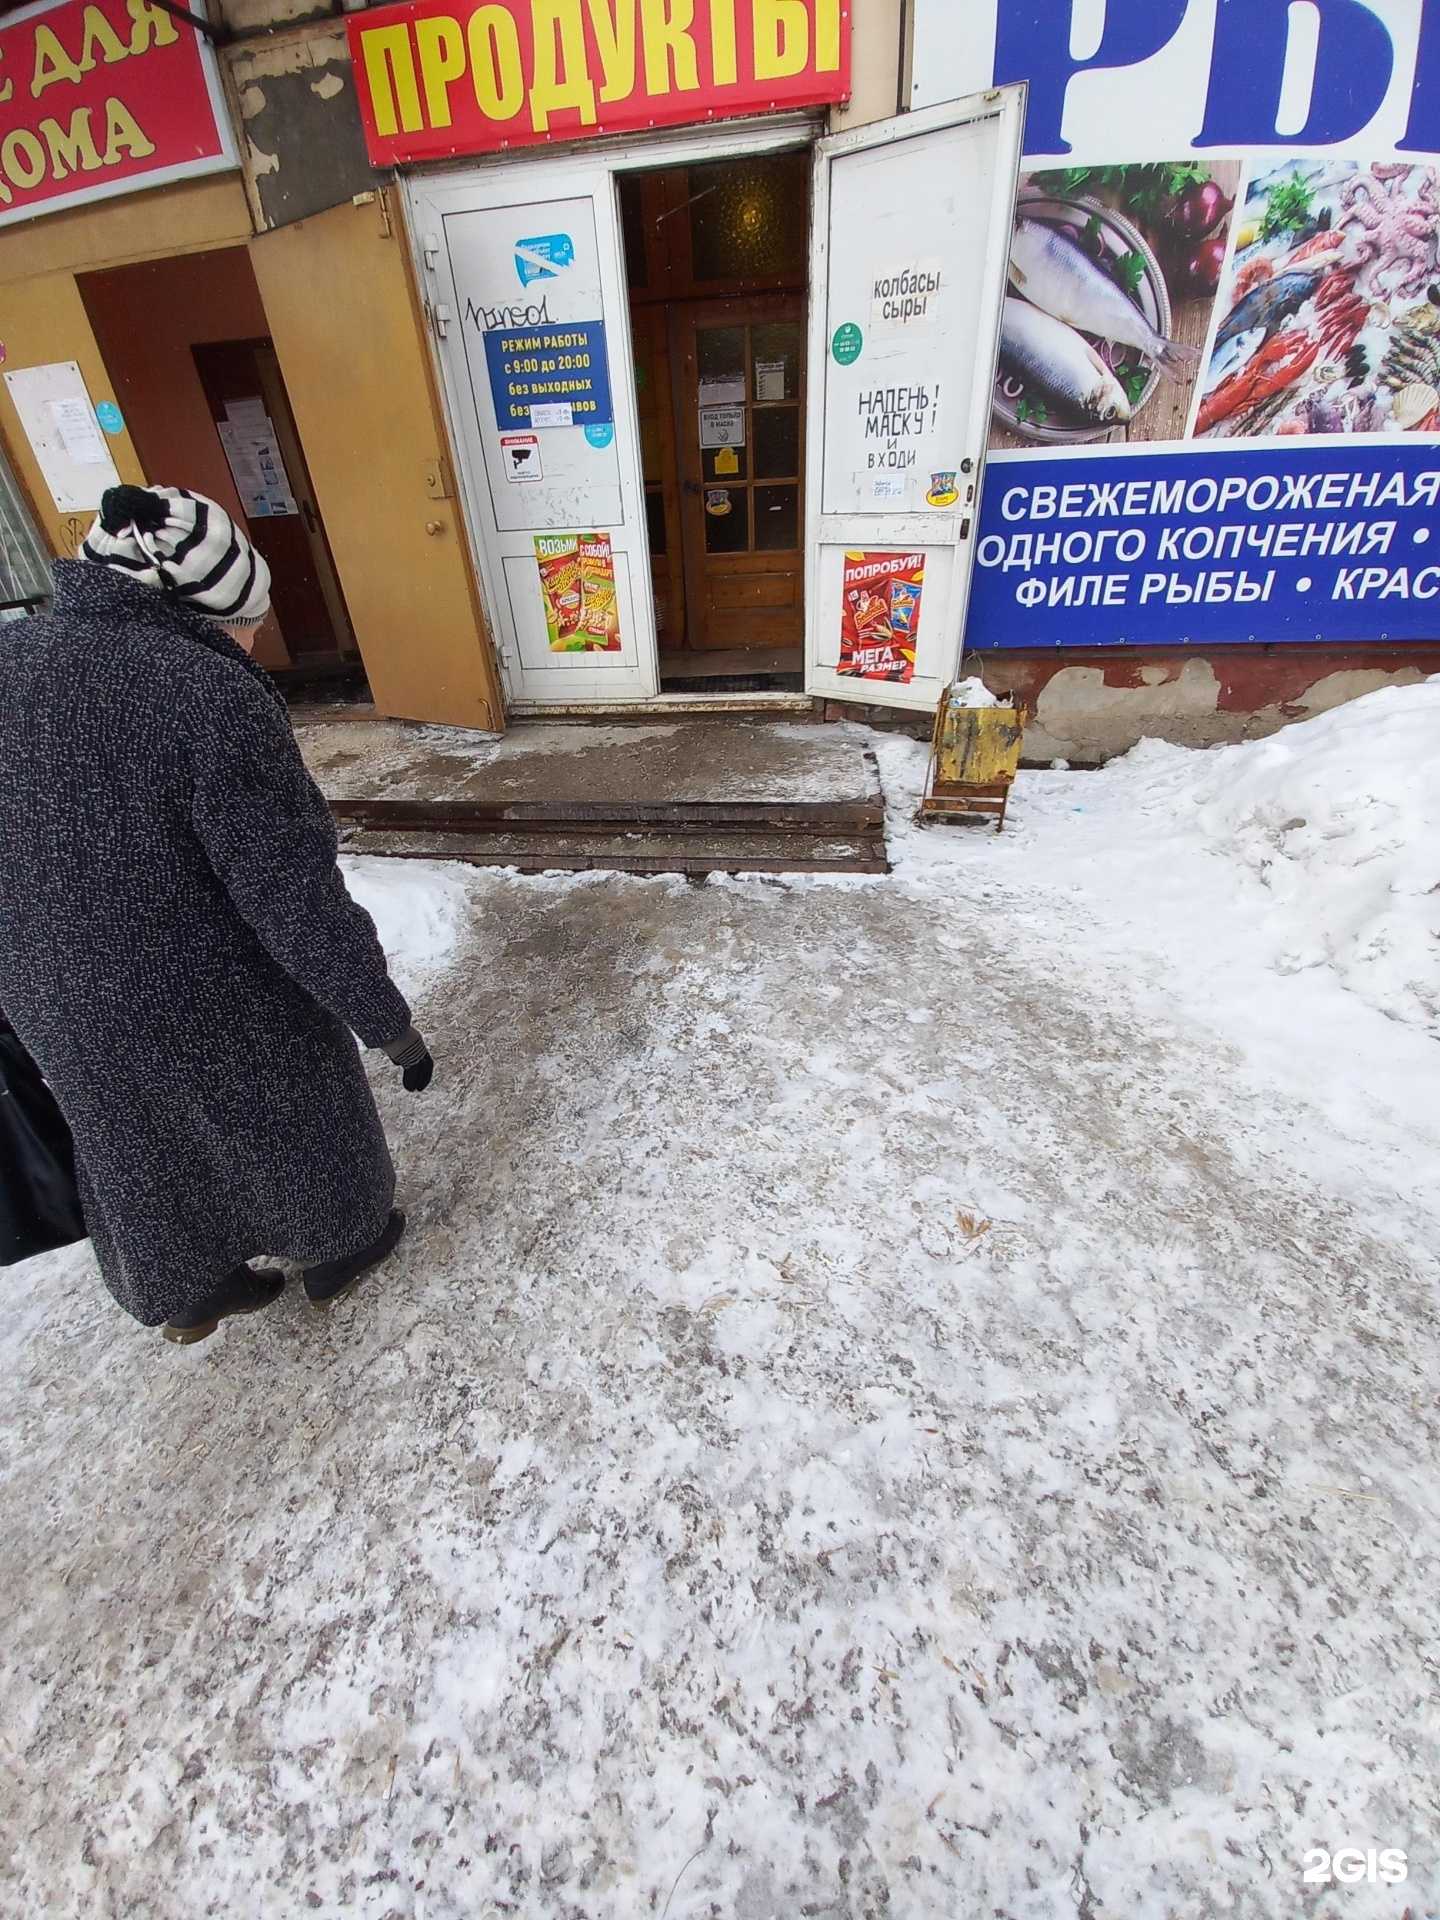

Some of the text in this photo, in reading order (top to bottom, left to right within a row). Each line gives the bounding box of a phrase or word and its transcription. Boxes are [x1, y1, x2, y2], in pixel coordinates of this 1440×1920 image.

[361, 0, 841, 136] ПРОДУКТЫ
[874, 269, 941, 299] колбасы
[882, 297, 928, 323] сыры
[501, 332, 588, 353] РЕЖИМ РАБОТЫ
[504, 353, 590, 374] с 9:00 до 20:00
[508, 378, 593, 396] без выходных
[509, 403, 530, 417] без
[1001, 471, 1440, 521] СВЕЖЕМОРОЖЕНАЯ
[976, 520, 1398, 572] ОДНОГО КОПЧЕНИЯ
[845, 555, 922, 582] ПОПРОБУЙ!
[1015, 573, 1129, 608] ФИЛЕ
[1138, 570, 1277, 604] РЫБЫ
[851, 646, 895, 666] МЕГА
[860, 660, 908, 673] РАЗМЕР
